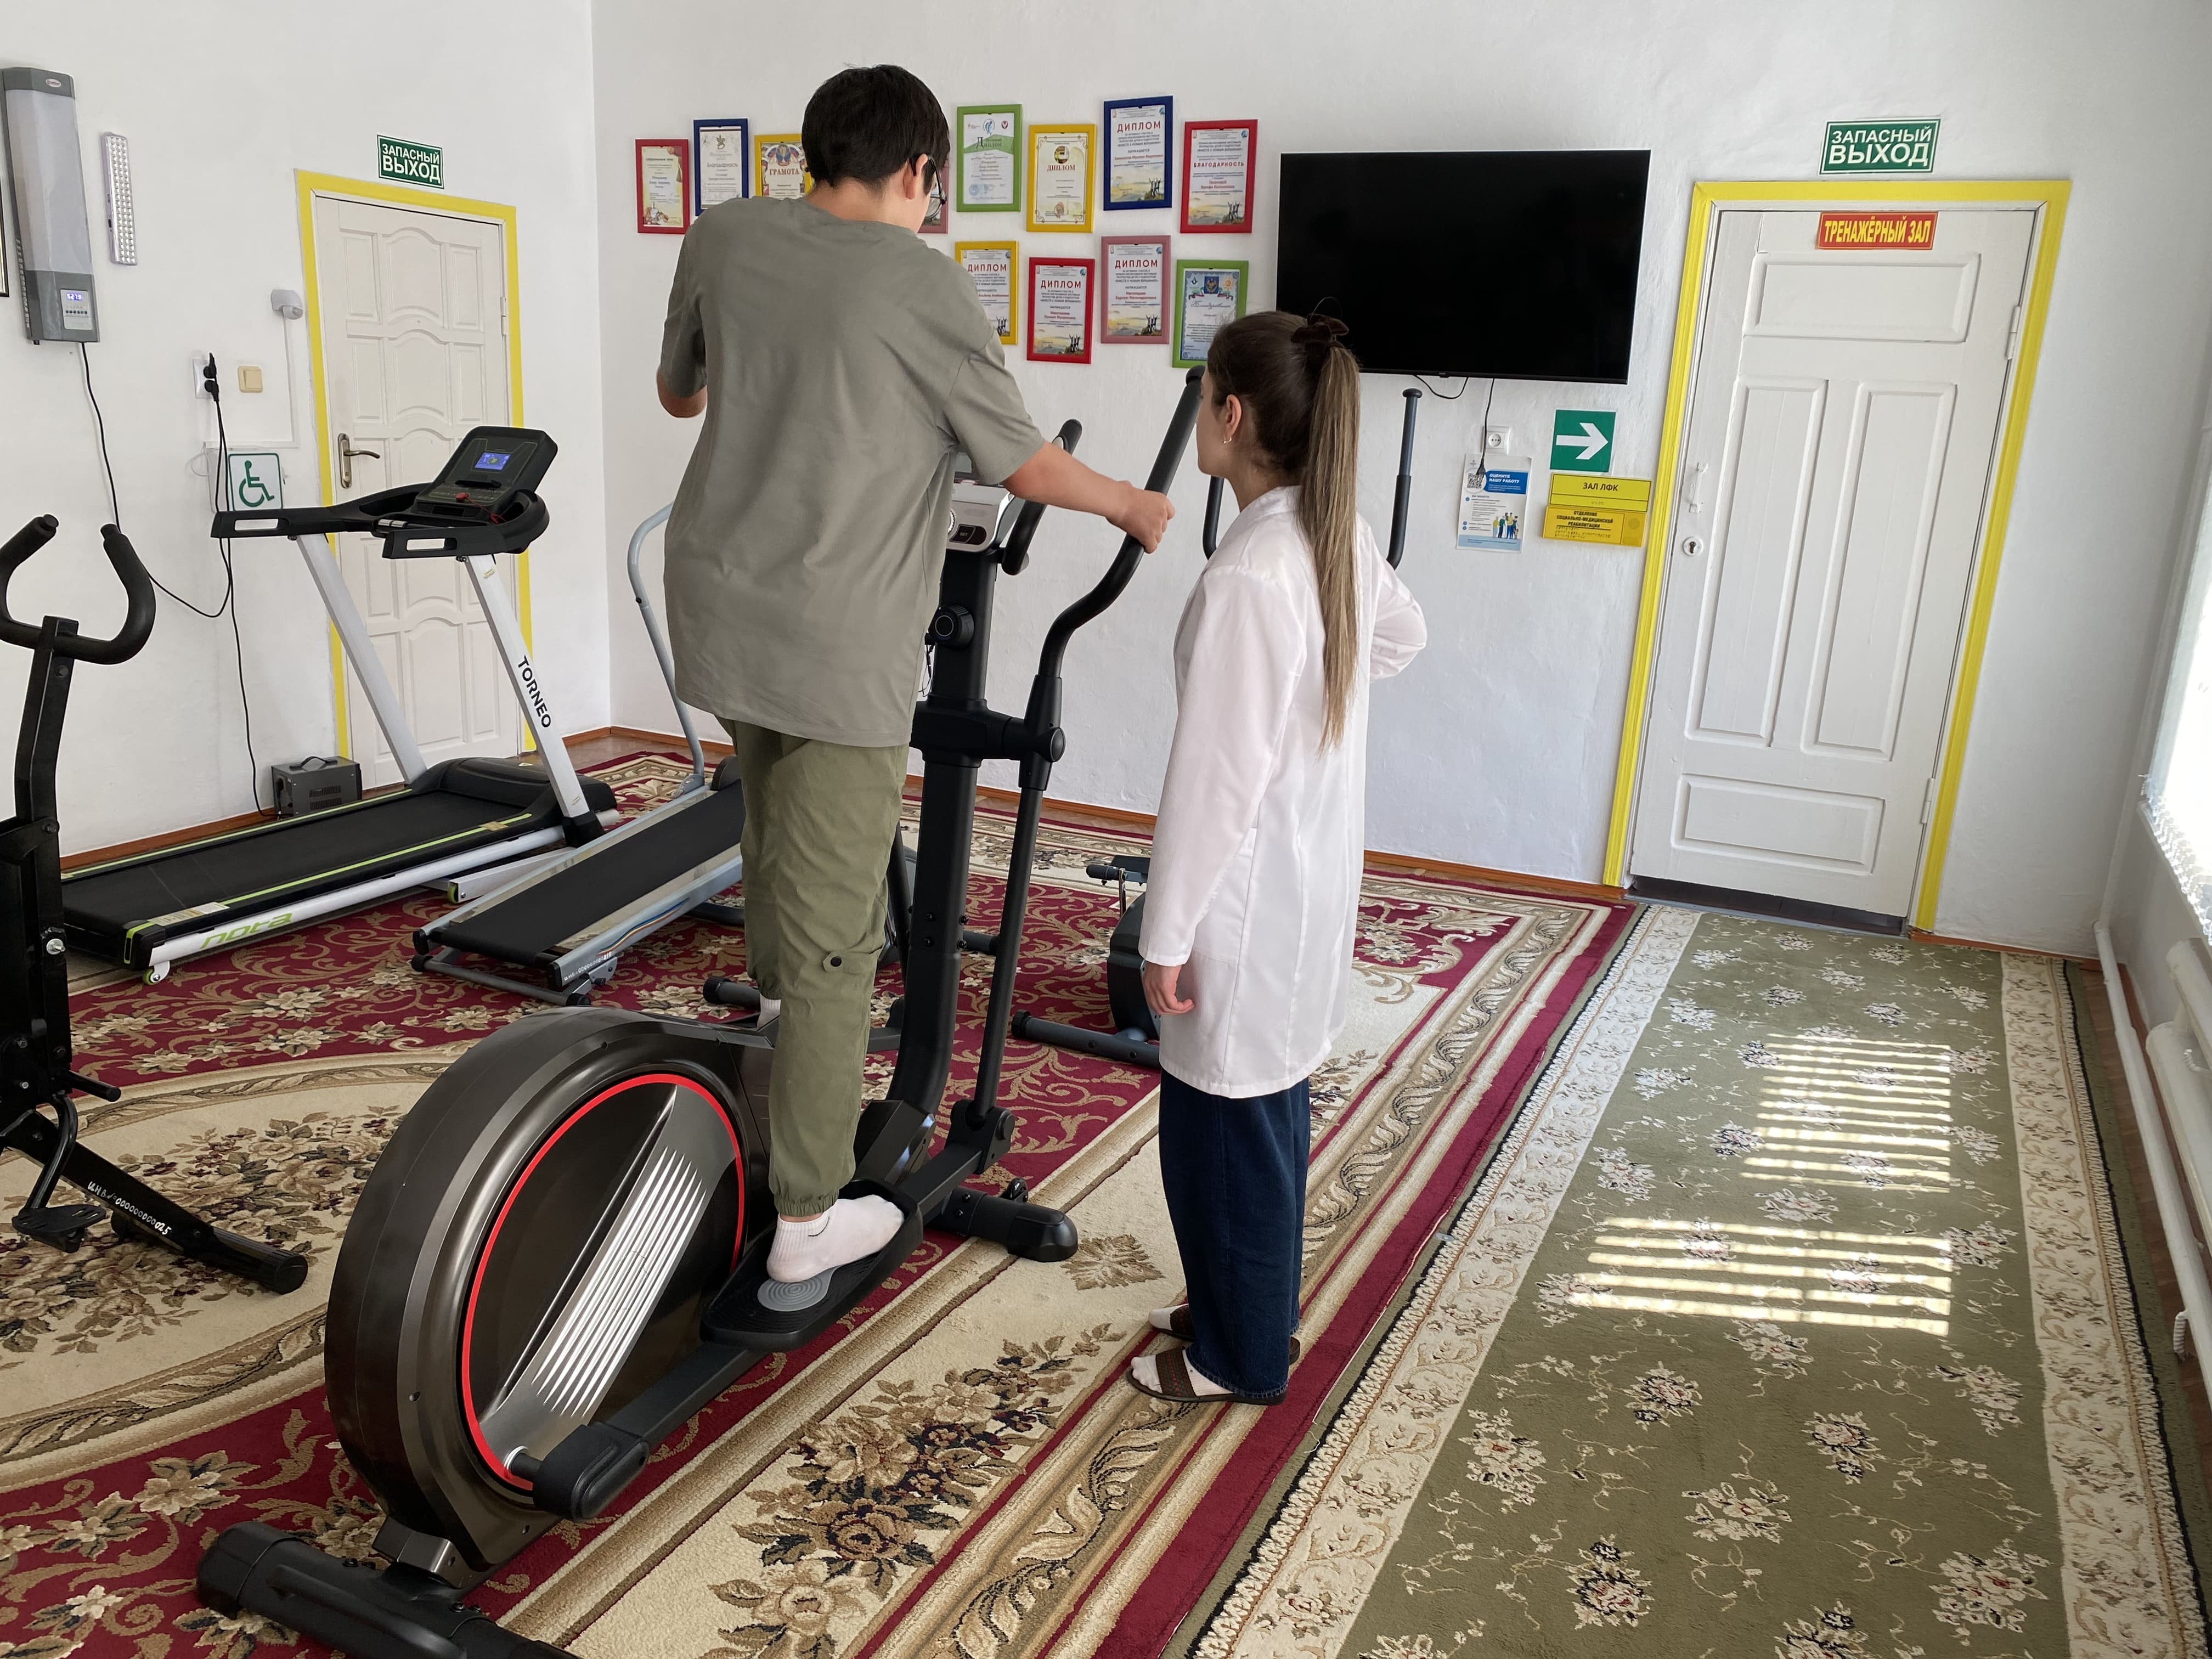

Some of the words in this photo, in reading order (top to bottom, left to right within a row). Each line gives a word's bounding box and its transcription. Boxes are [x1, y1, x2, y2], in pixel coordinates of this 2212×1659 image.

[1117, 121, 1160, 133] ДИПЛОМ
[1831, 125, 1932, 144] ЗАПАСНЫЙ
[382, 143, 439, 165] ЗАПАСНЫЙ
[1829, 142, 1929, 167] ВЫХОД
[382, 155, 441, 184] ВЫХОД
[1824, 216, 1907, 243] ТРЕНАЖЁРНЫЙ
[1908, 220, 1932, 243] ЗАЛ
[968, 264, 1007, 273] ДИПЛОМ
[1115, 259, 1158, 269] ДИПЛОМ
[1040, 280, 1081, 289] ДИПЛОМ
[1600, 483, 1618, 492] ЛФК
[518, 654, 551, 727] TORNEO
